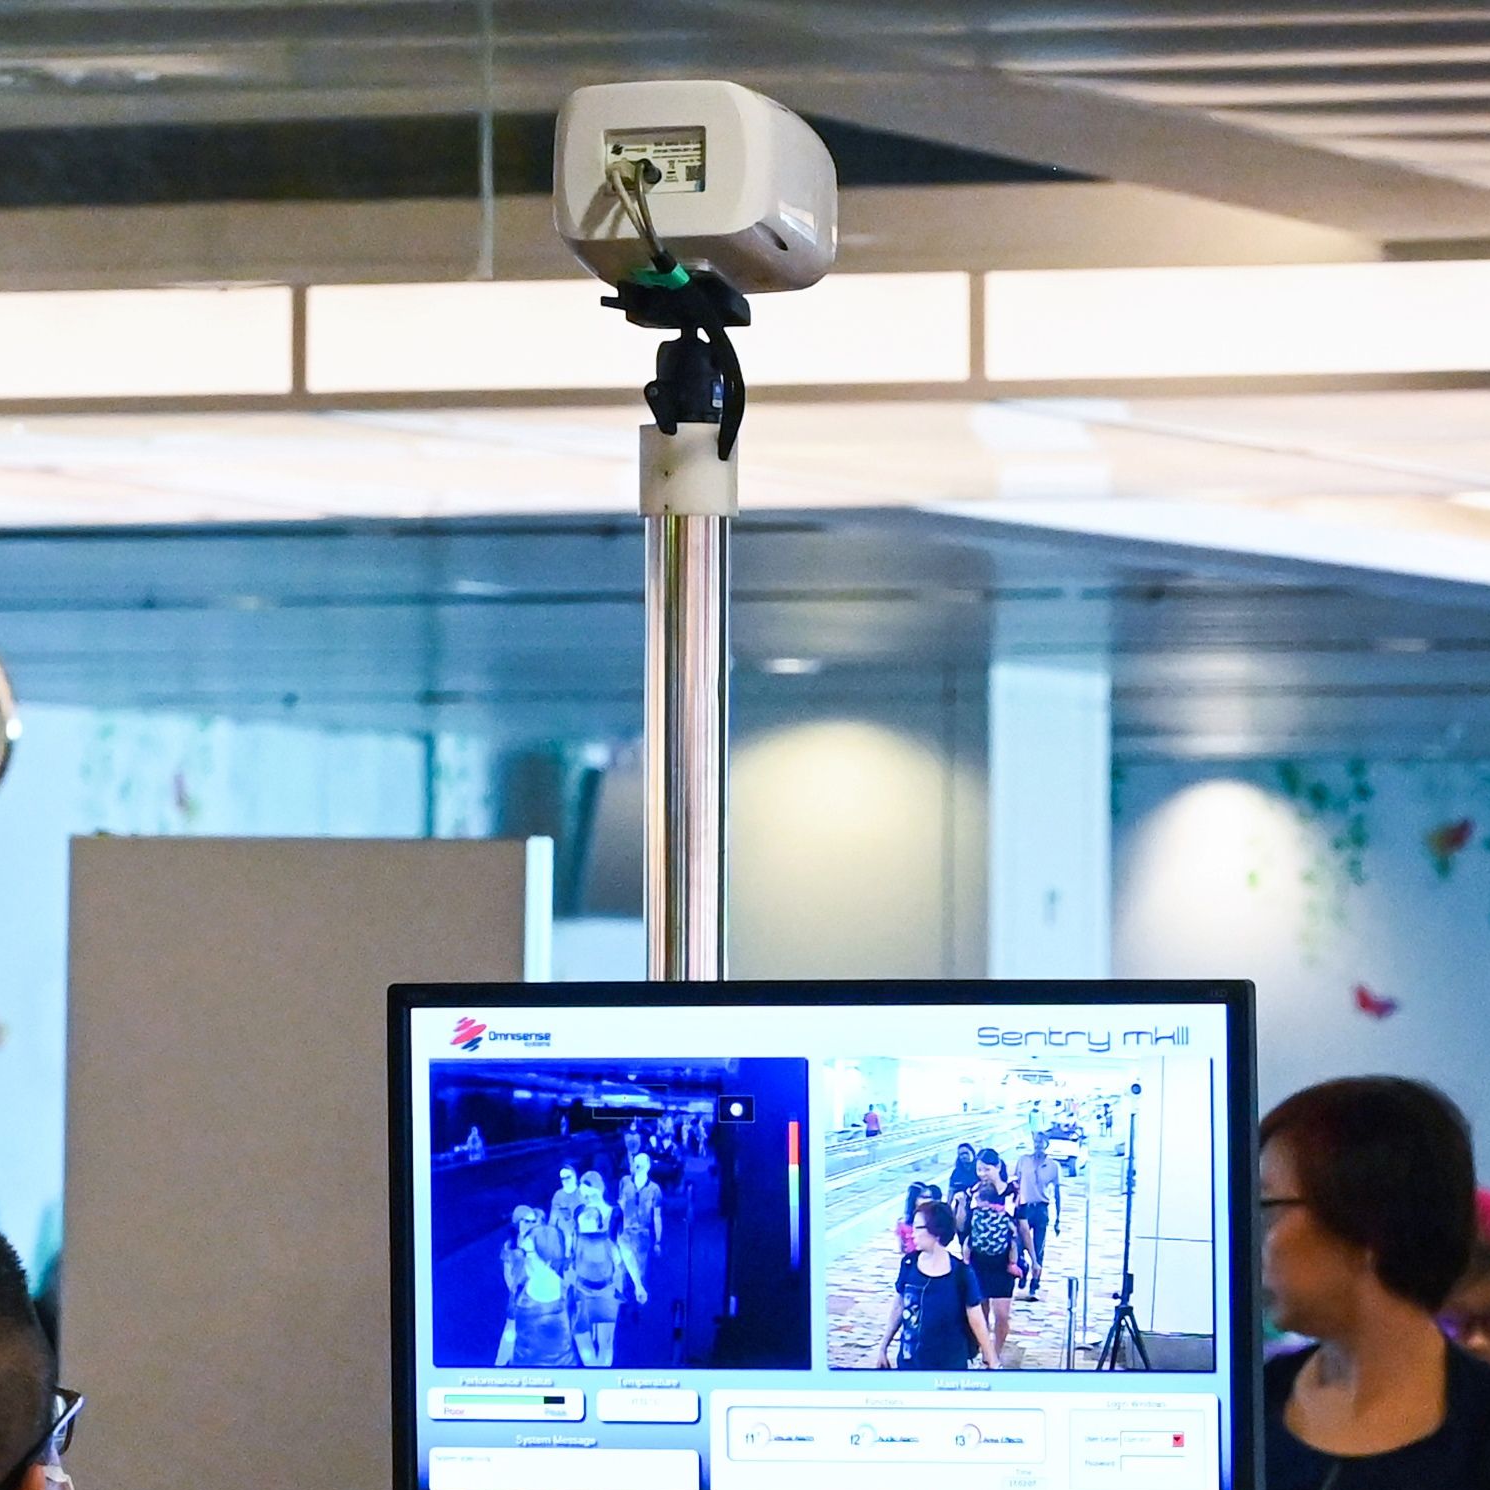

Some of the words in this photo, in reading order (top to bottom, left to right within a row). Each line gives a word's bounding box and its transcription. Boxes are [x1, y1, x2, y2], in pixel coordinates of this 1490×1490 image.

[977, 1026, 1111, 1053] Sentry
[617, 1375, 680, 1388] Temperature
[515, 1434, 552, 1447] System
[552, 1434, 598, 1448] Message
